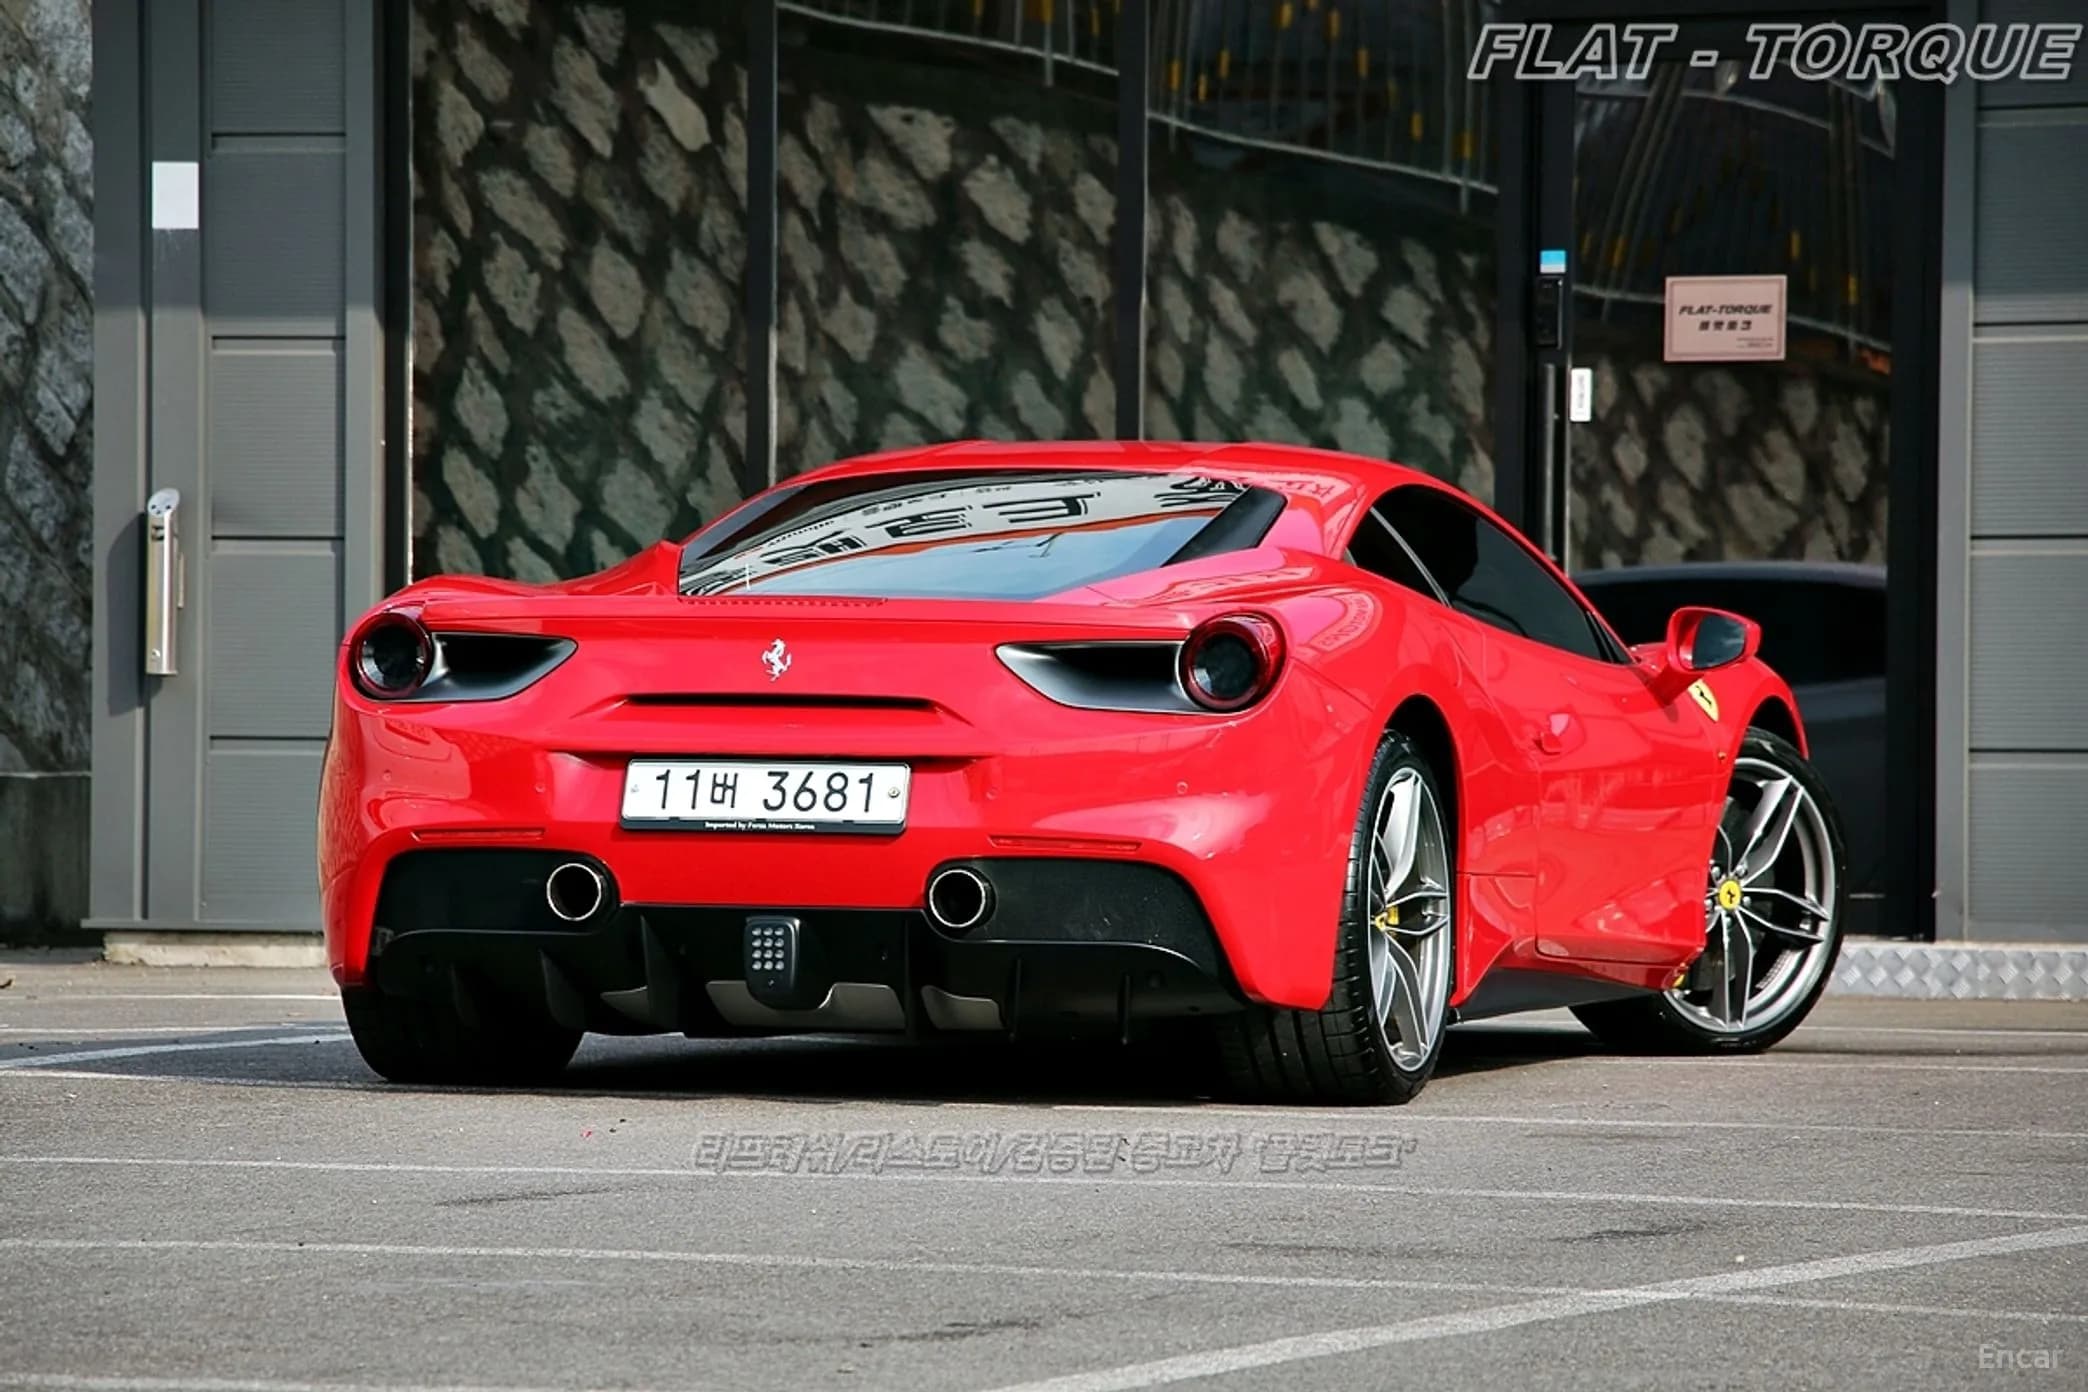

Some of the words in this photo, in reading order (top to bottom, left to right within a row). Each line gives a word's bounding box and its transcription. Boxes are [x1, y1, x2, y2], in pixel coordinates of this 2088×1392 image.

[1678, 304, 1773, 316] FLAT-TORQUE
[656, 768, 738, 810] 11버
[762, 771, 874, 813] 3681
